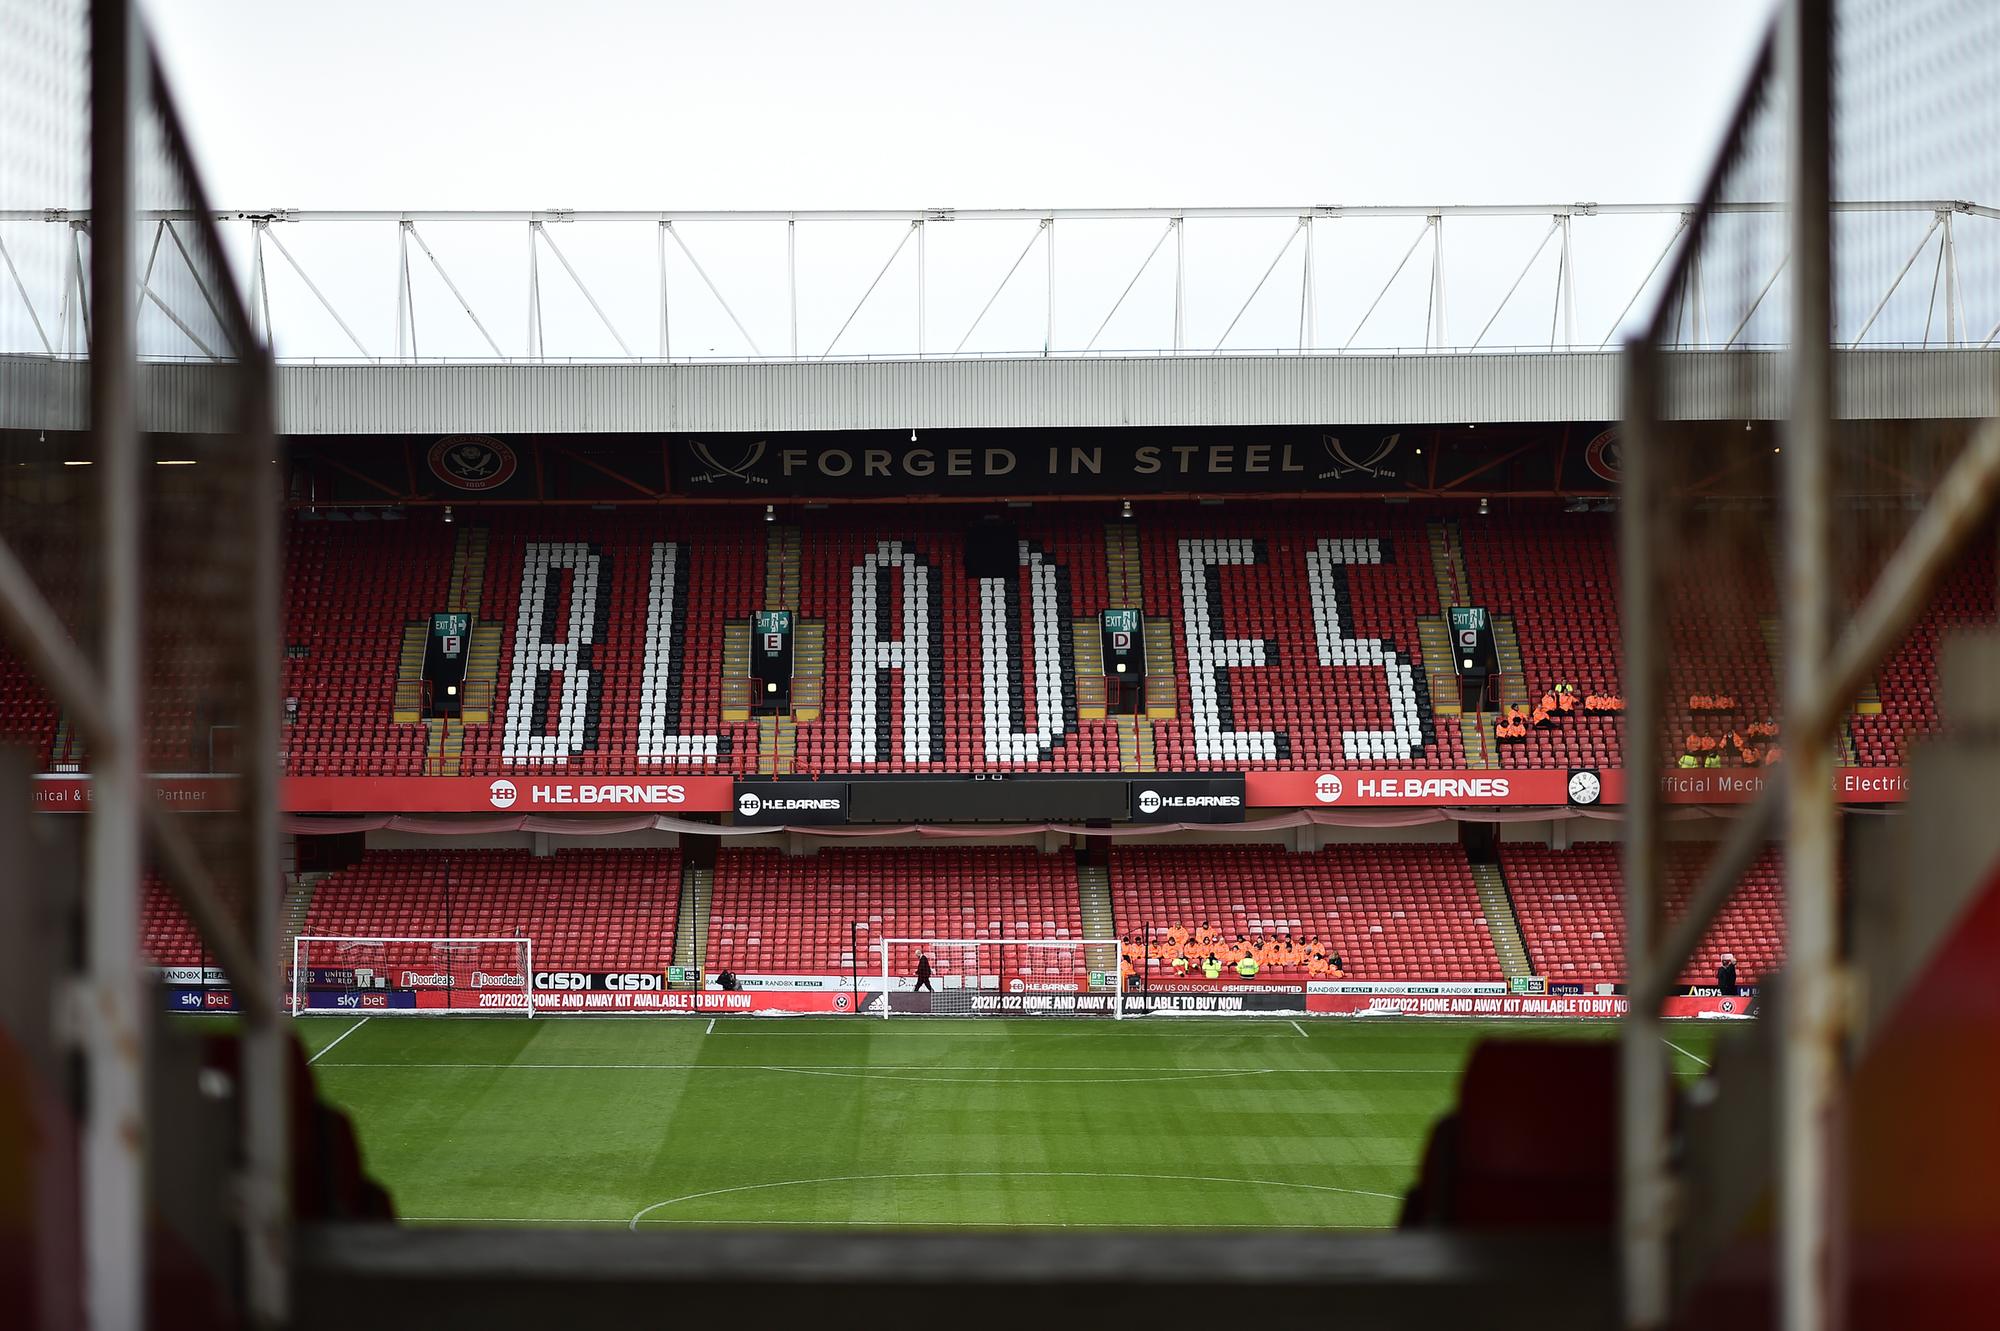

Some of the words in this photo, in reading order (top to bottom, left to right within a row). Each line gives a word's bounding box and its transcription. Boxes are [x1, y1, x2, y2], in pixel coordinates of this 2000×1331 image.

[782, 449, 1017, 477] FORGED
[1049, 447, 1102, 474] IN
[1134, 444, 1304, 473] STEEL
[435, 621, 449, 630] EXIT
[758, 619, 770, 627] EXIT
[1105, 616, 1121, 627] EXIT
[1453, 614, 1468, 624] EXIT
[447, 638, 456, 651] F
[768, 635, 778, 648] E
[1115, 633, 1128, 647] D
[1462, 631, 1475, 645] C
[1357, 778, 1510, 798] H.E.BARNES
[1660, 776, 1710, 792] fficial
[1718, 775, 1766, 792] Mech
[1844, 774, 1910, 791] Electric
[33, 789, 68, 800] nical
[73, 789, 82, 800] &
[157, 788, 207, 801] Partner
[532, 785, 685, 803] H.E.BARNES
[762, 799, 841, 810] H.E.BARNES
[1162, 796, 1241, 807] H.E.BARNES
[325, 969, 352, 978] UNITED
[482, 974, 524, 985] Doordeals
[535, 972, 591, 990] CISDI
[605, 973, 661, 990] CISDI
[1222, 984, 1302, 993] @SHEFFIELDUNITED
[1552, 985, 1578, 993] UNITED
[181, 993, 202, 1007] sky
[207, 994, 229, 1005] bet
[337, 994, 359, 1007] sky
[363, 995, 384, 1006] bet
[479, 993, 529, 1007] 2021/2022
[562, 994, 584, 1007] AND
[585, 994, 614, 1007] AWAY
[616, 994, 633, 1007] KIT
[634, 994, 688, 1008] AVAILABLE
[704, 995, 726, 1008] BUY
[727, 995, 751, 1008] NOW
[1023, 996, 1052, 1009] HOME
[1053, 996, 1076, 1009] AND
[1076, 997, 1105, 1010] AWAY
[1107, 997, 1124, 1010] KI
[1125, 997, 1180, 1010] AVAILABLE
[1181, 997, 1195, 1010] TO
[1196, 997, 1217, 1010] BUY
[1218, 997, 1242, 1010] NOW
[1368, 998, 1419, 1012] 2021/2022
[1420, 999, 1450, 1012] HOME
[1451, 999, 1473, 1012] AND
[1473, 999, 1502, 1012] AWAY
[1504, 999, 1520, 1012] KIT
[1521, 999, 1576, 1012] AVAILABLE
[1577, 1000, 1591, 1012] TO
[1592, 1000, 1612, 1012] BUY
[1614, 1000, 1630, 1013] NO
